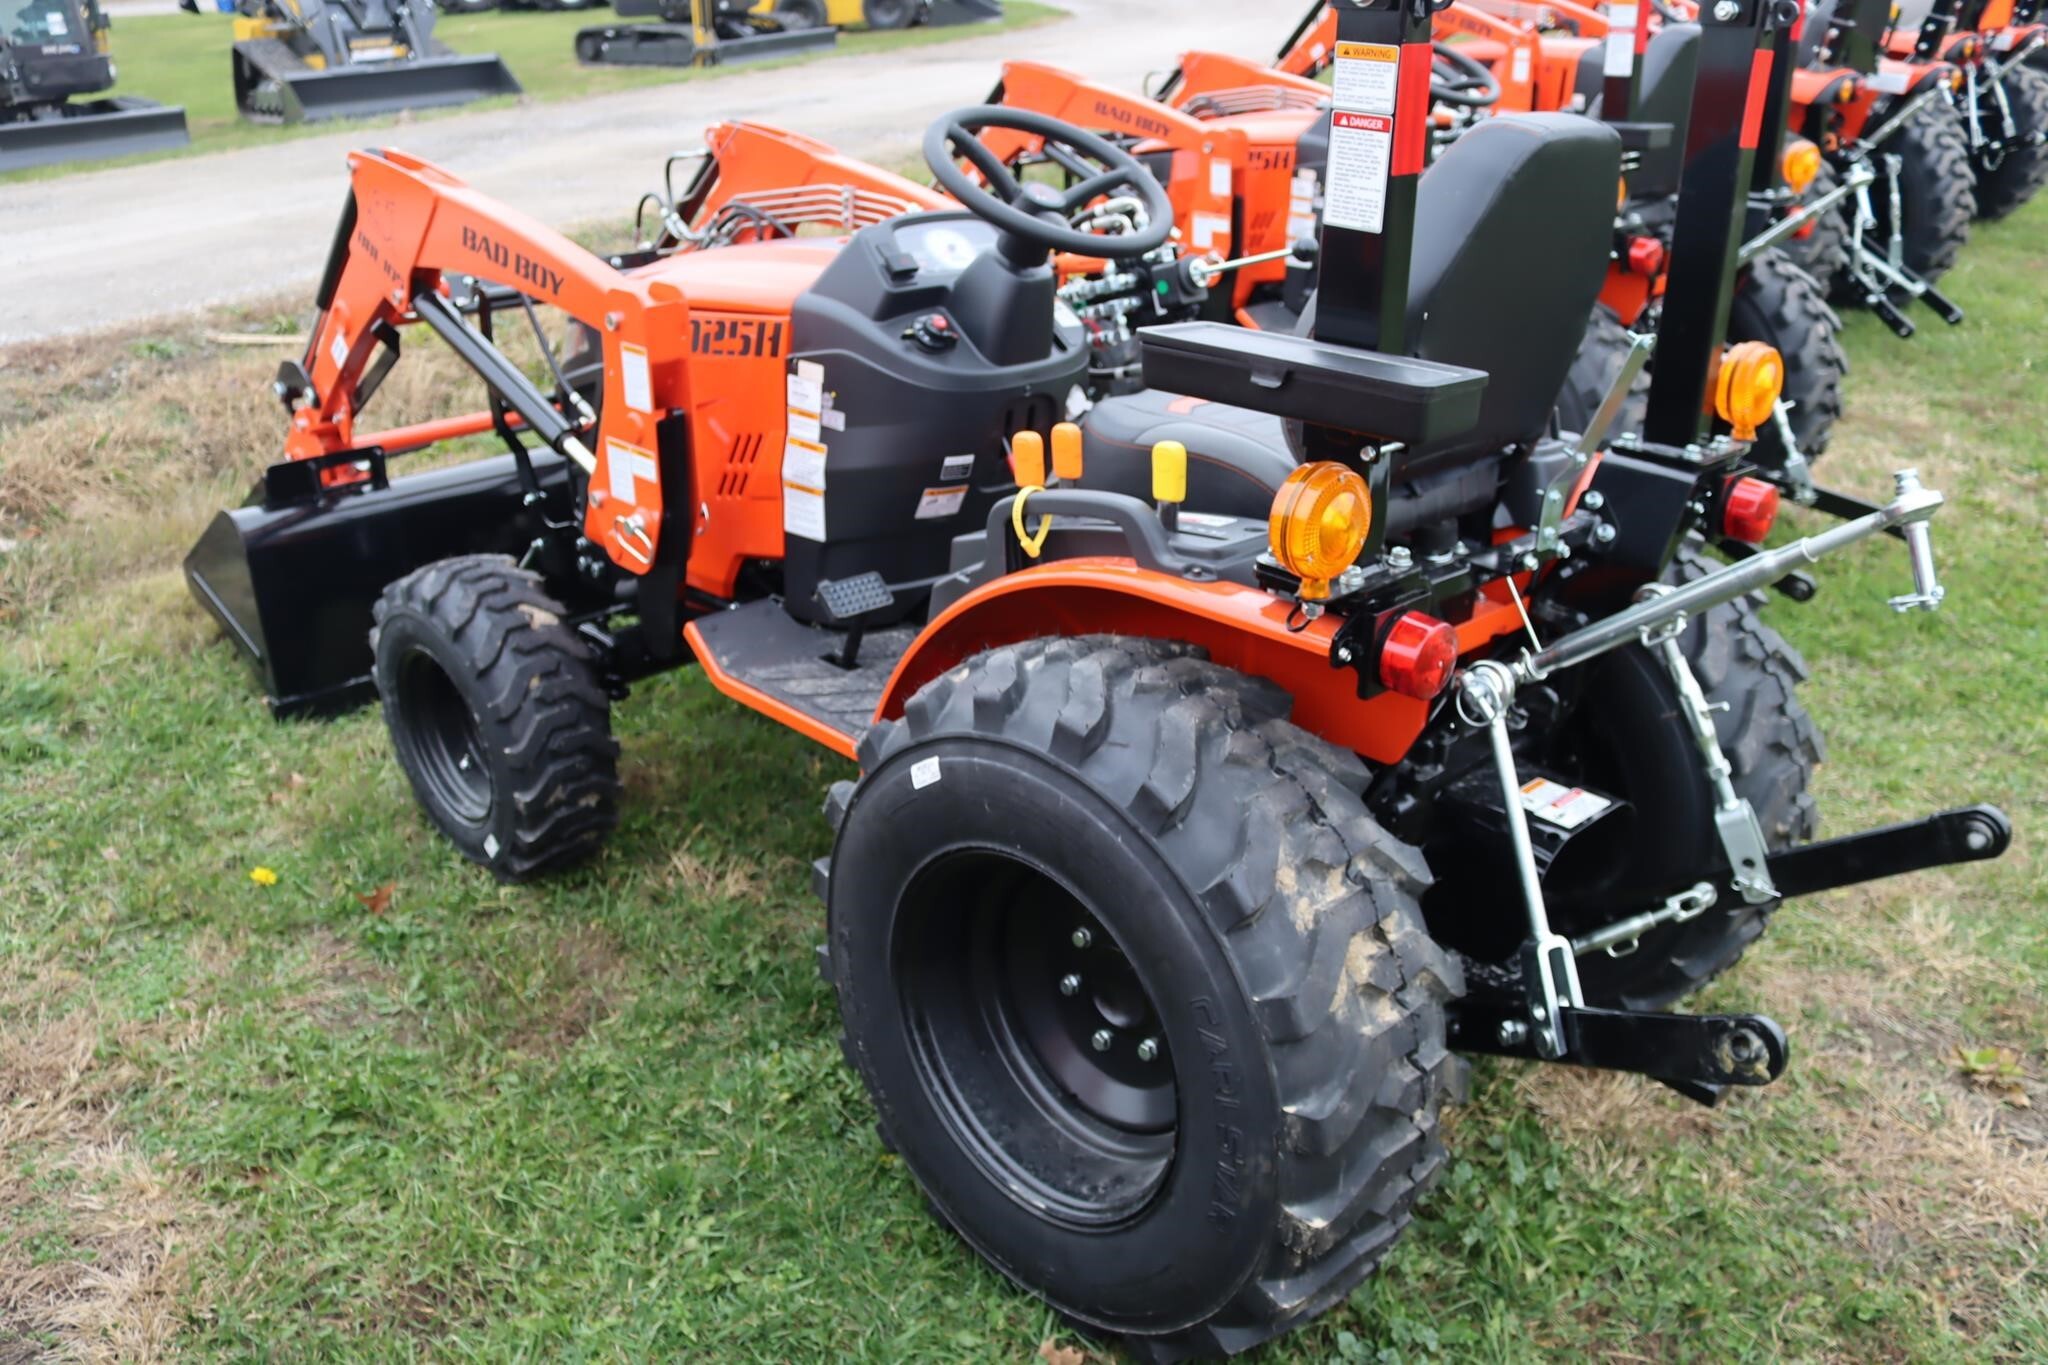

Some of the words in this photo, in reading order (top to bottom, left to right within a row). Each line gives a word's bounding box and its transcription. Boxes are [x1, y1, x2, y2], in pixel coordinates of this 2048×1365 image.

[1352, 48, 1392, 59] WARNING
[1094, 101, 1132, 124] BAD
[1349, 115, 1384, 129] DANGER
[462, 226, 509, 269] BAD
[515, 253, 564, 296] BOY
